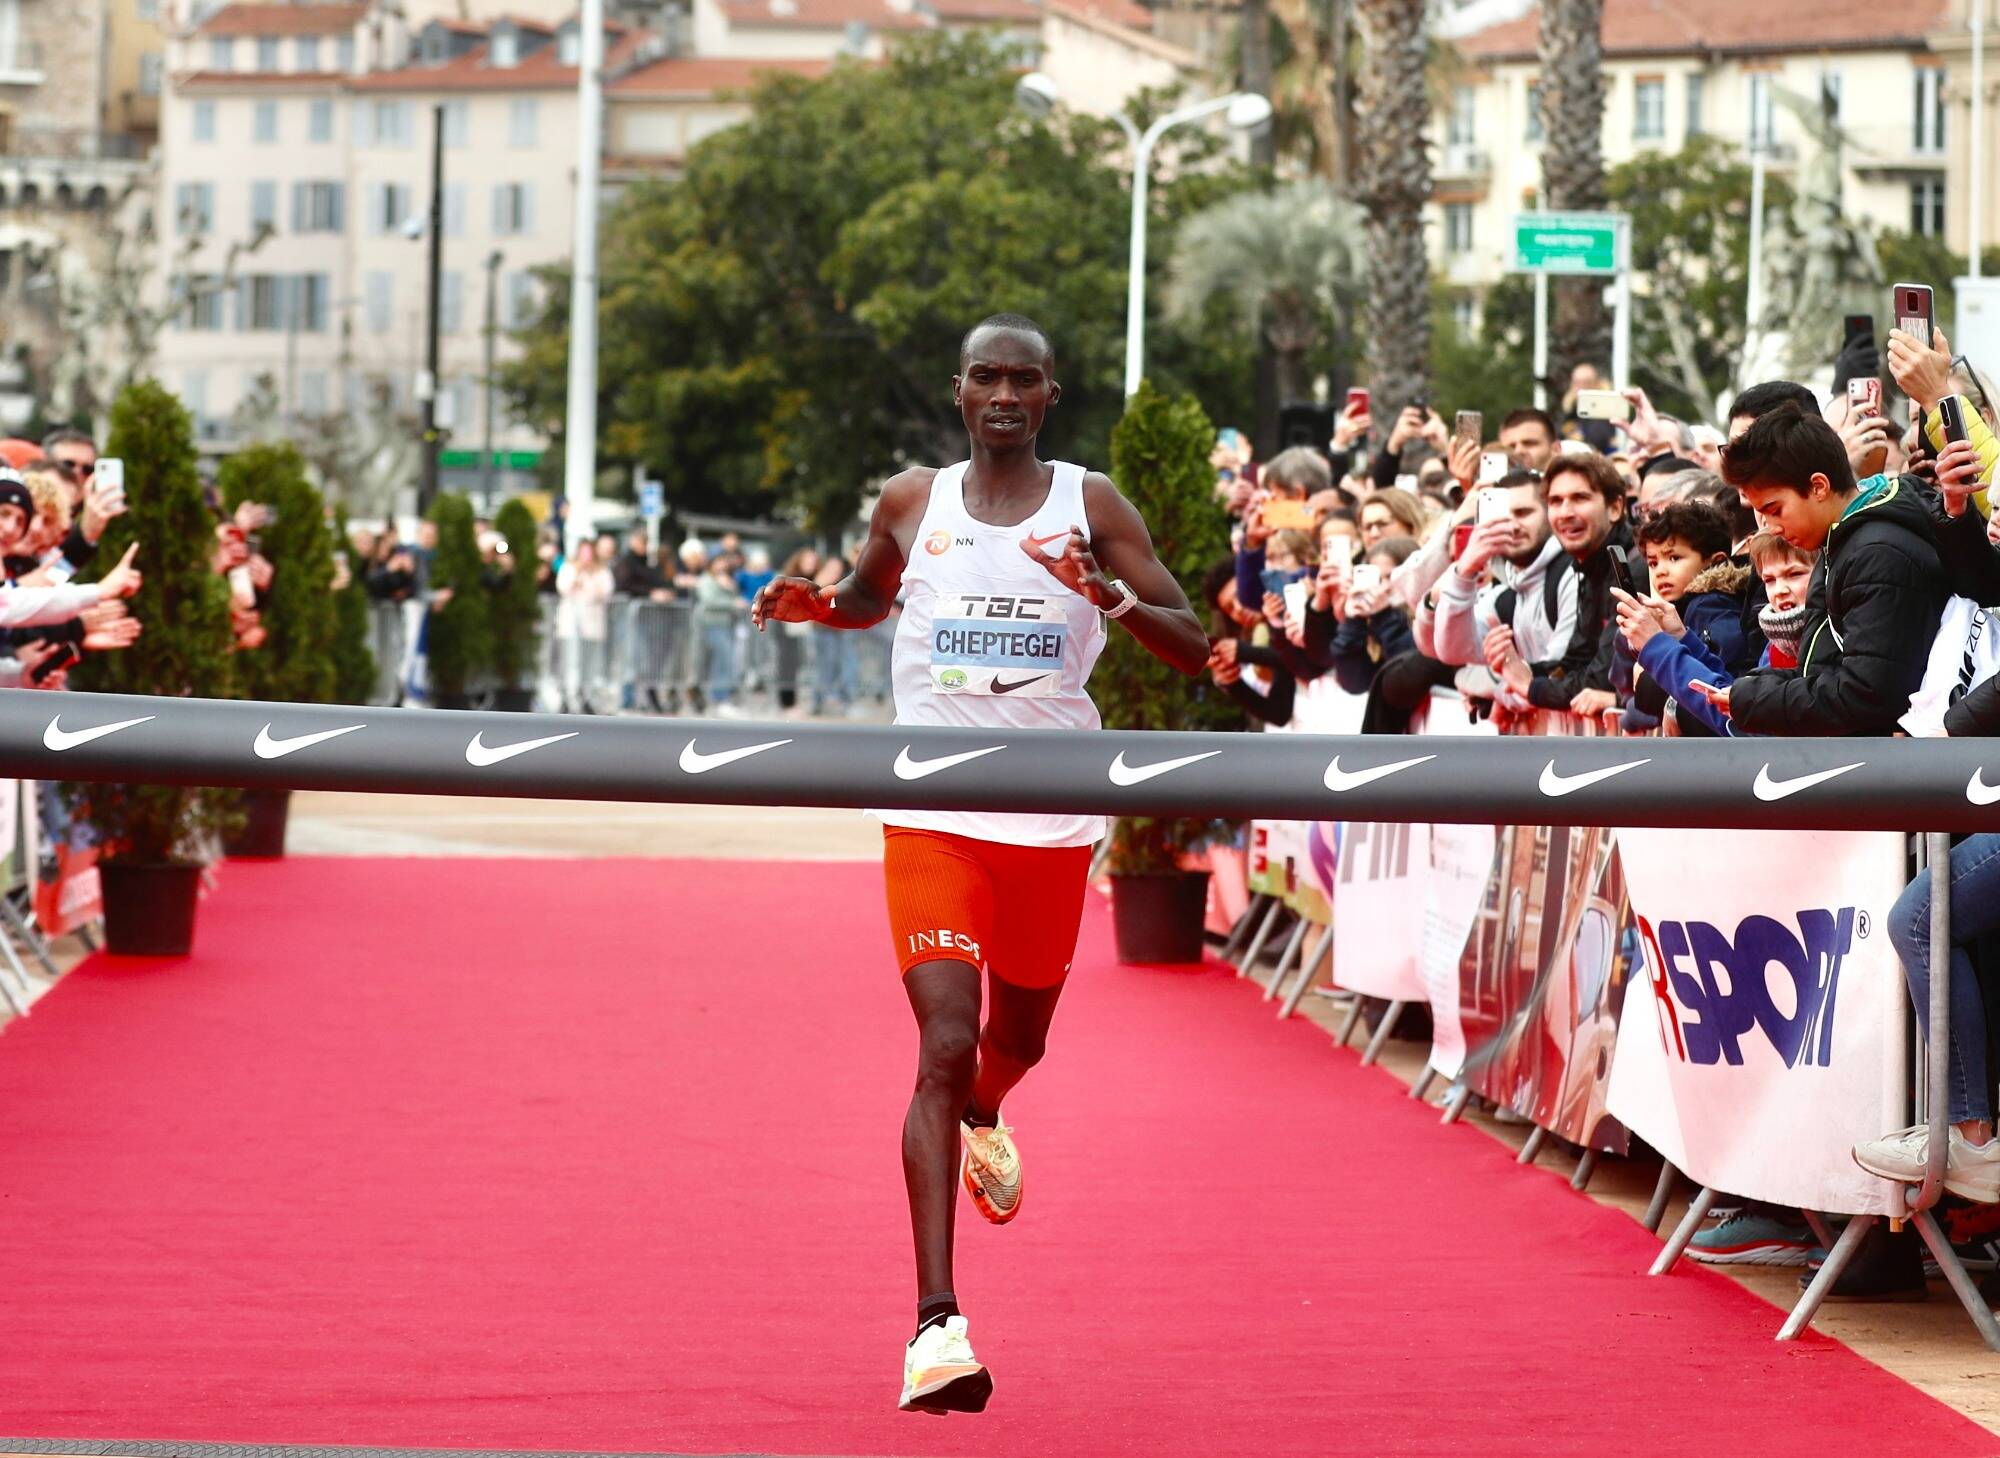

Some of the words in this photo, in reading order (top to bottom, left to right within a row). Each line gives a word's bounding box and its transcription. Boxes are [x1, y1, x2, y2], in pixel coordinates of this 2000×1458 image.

[956, 538, 974, 546] NN
[961, 595, 1045, 620] TBC
[936, 629, 1062, 658] CHEPTEGEI
[908, 929, 981, 960] INEOS
